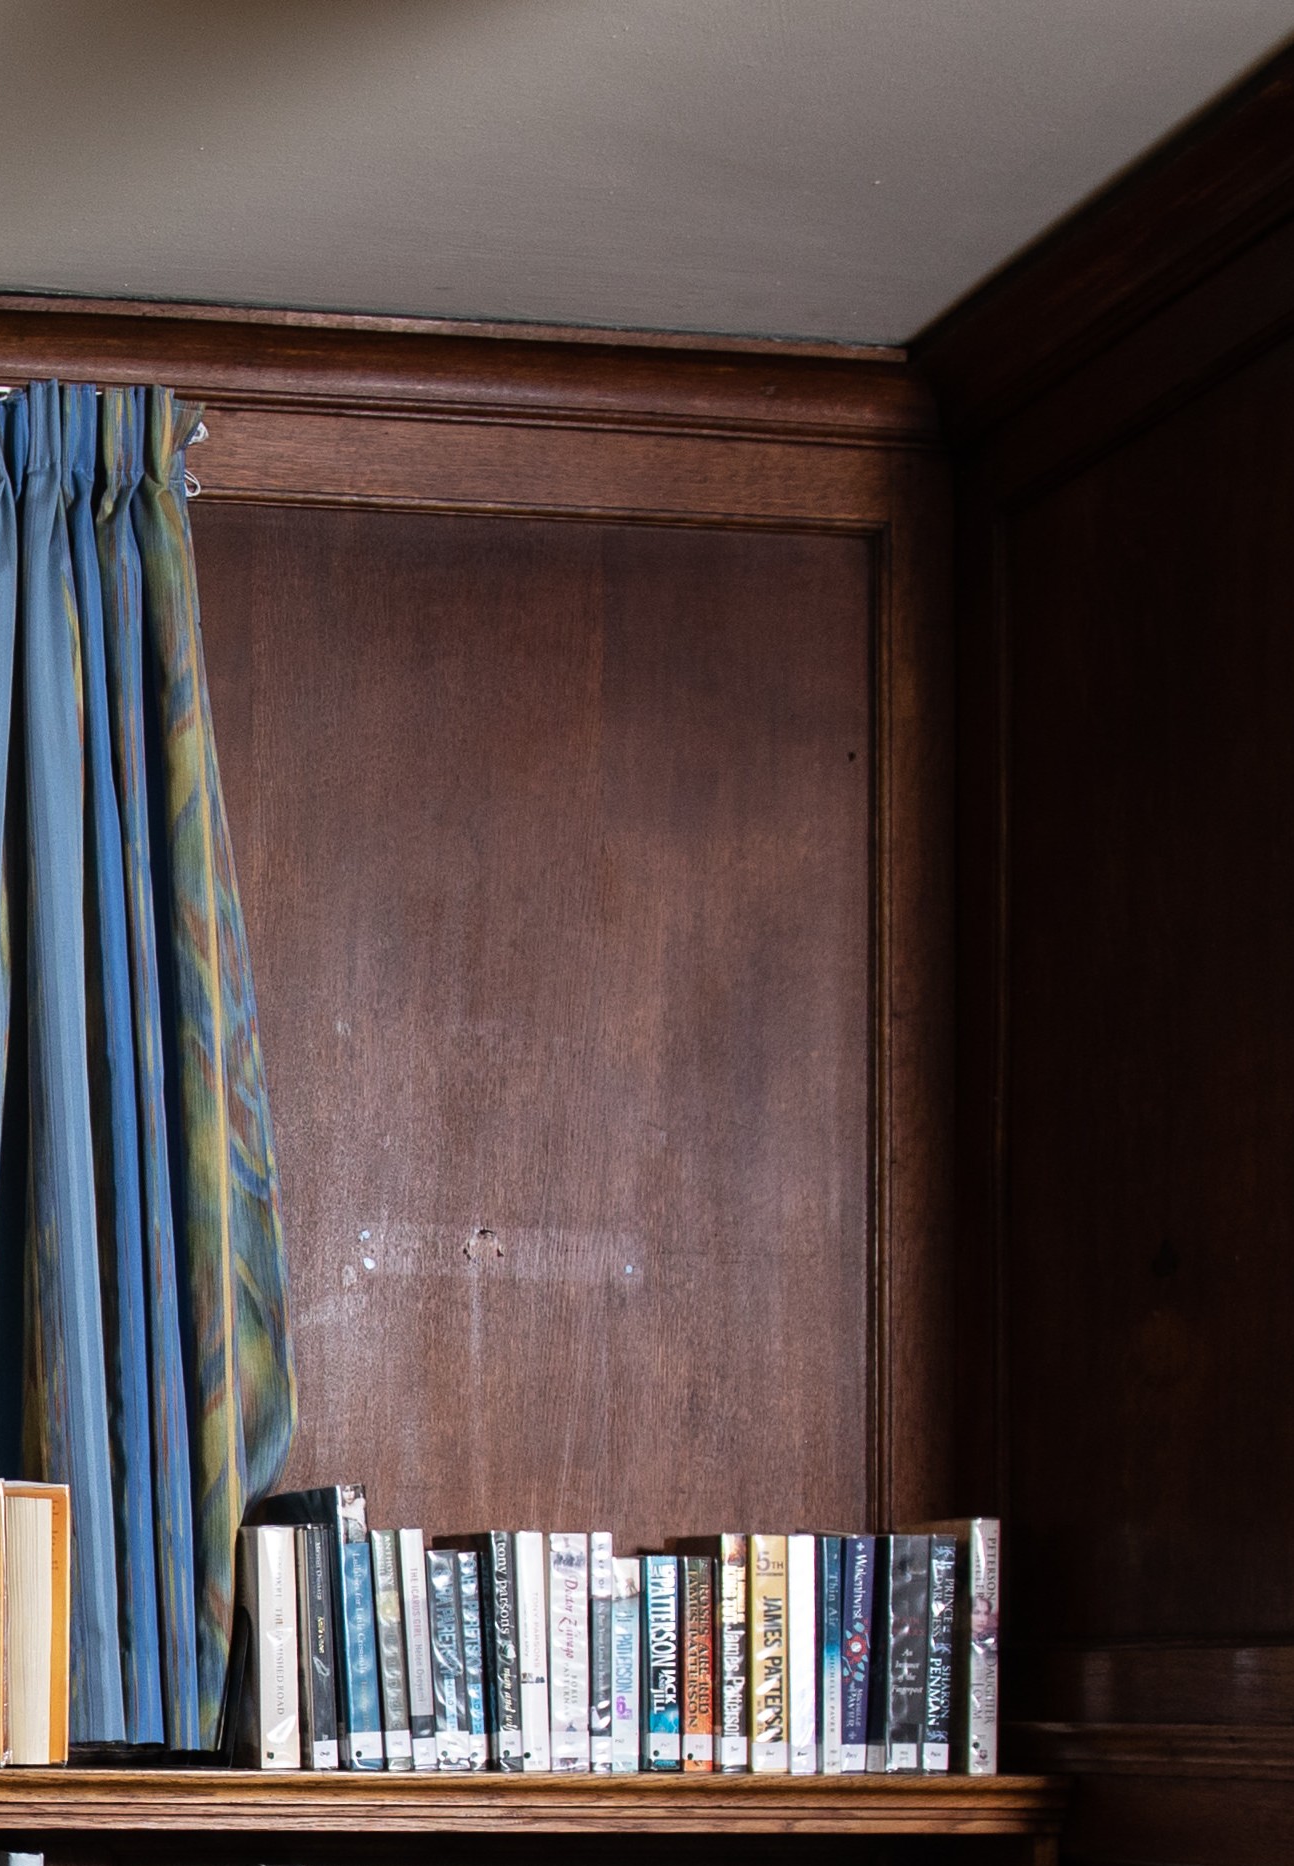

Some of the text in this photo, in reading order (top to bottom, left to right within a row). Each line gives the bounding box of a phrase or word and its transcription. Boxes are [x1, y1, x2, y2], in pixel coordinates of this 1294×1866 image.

[495, 1543, 508, 1574] tony
[494, 1580, 511, 1634] parsons
[650, 1578, 676, 1667] PATTERSON
[764, 1595, 783, 1648] JAMES
[723, 1626, 745, 1671] James
[688, 1629, 698, 1728] PATTERSON
[928, 1658, 941, 1726] PENMAN
[940, 1666, 951, 1718] SHARON
